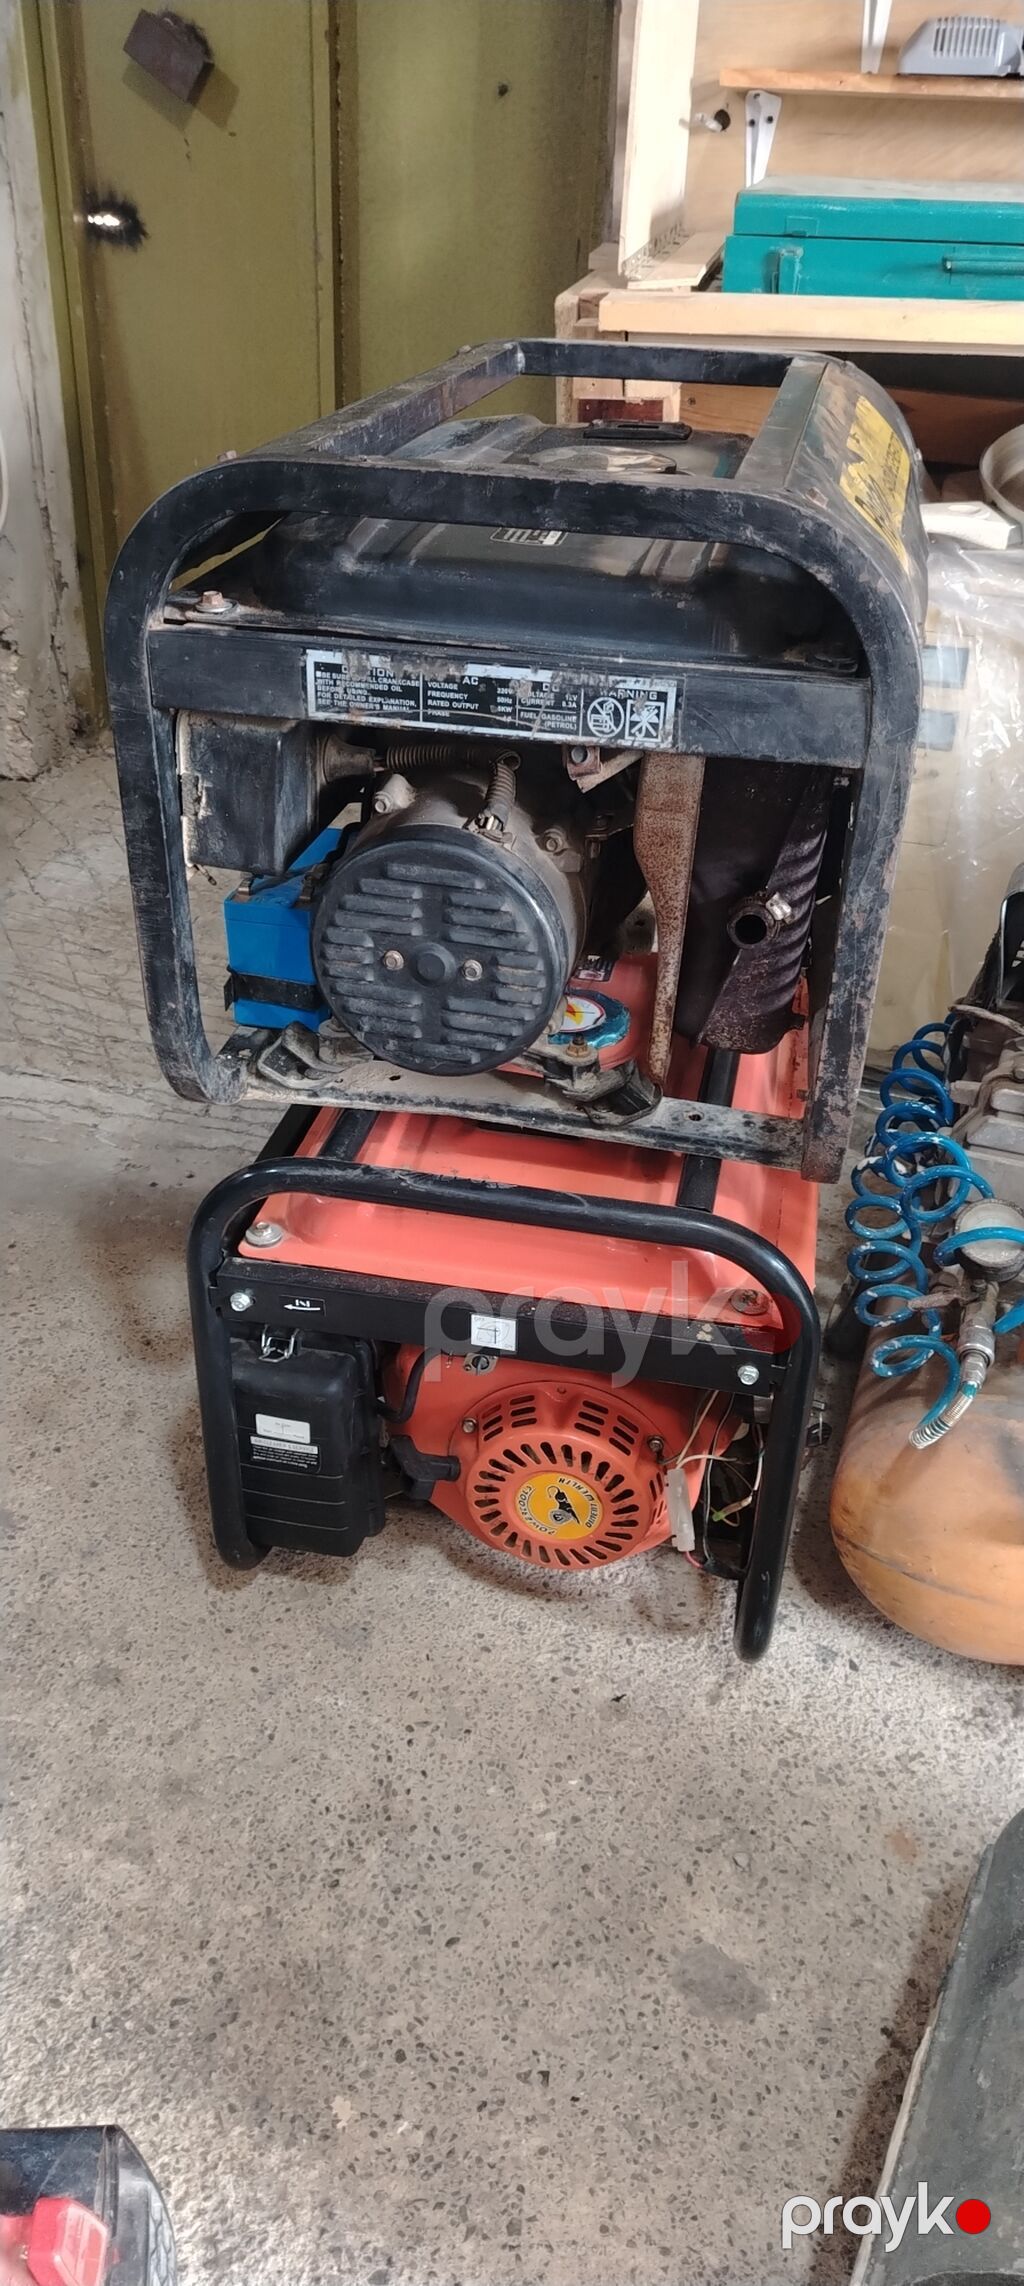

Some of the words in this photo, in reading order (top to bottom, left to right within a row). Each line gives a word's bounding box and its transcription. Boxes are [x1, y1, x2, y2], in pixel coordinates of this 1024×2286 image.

[427, 681, 459, 691] VOLTAGE
[462, 676, 480, 686] AC
[542, 682, 562, 693] DC
[427, 690, 469, 701] FREQUENCY
[427, 699, 450, 708] RATED
[451, 701, 480, 711] OUTPUT
